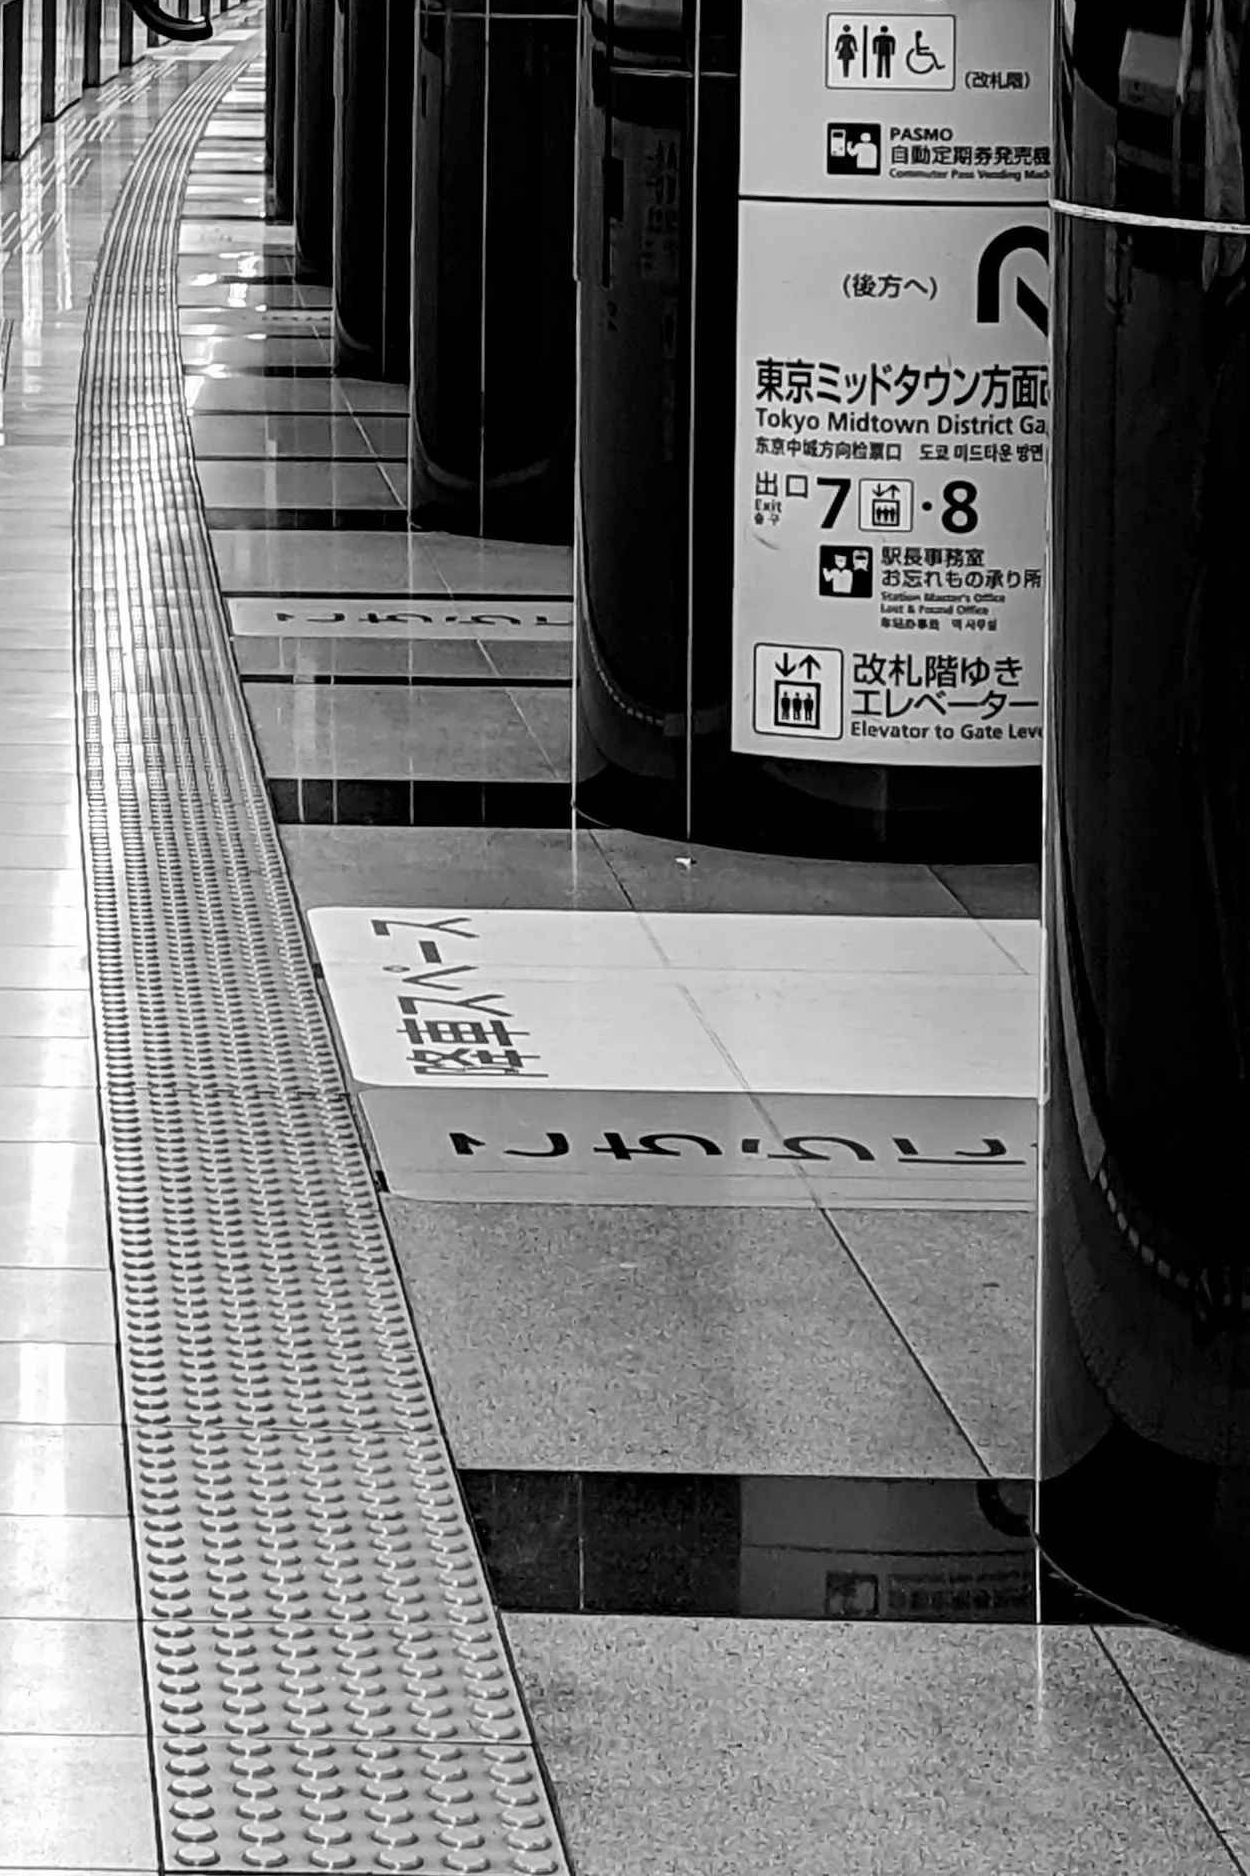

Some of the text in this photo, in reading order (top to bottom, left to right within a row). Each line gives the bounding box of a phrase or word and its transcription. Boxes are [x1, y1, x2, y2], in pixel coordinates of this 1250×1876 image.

[889, 127, 954, 142] PASMO
[842, 272, 938, 300] (後方へ)
[755, 406, 1047, 436] Tokyo Midtown District Ga
[755, 470, 808, 499] 出口
[816, 476, 851, 530] 7
[941, 479, 979, 535] 8
[881, 568, 1041, 590] お忘れもの承り所
[852, 651, 1024, 689] 改札階ゆき
[850, 687, 1040, 721] エレベーター
[850, 720, 930, 739] Elevator
[934, 723, 955, 740] to
[960, 723, 1003, 740] Gate
